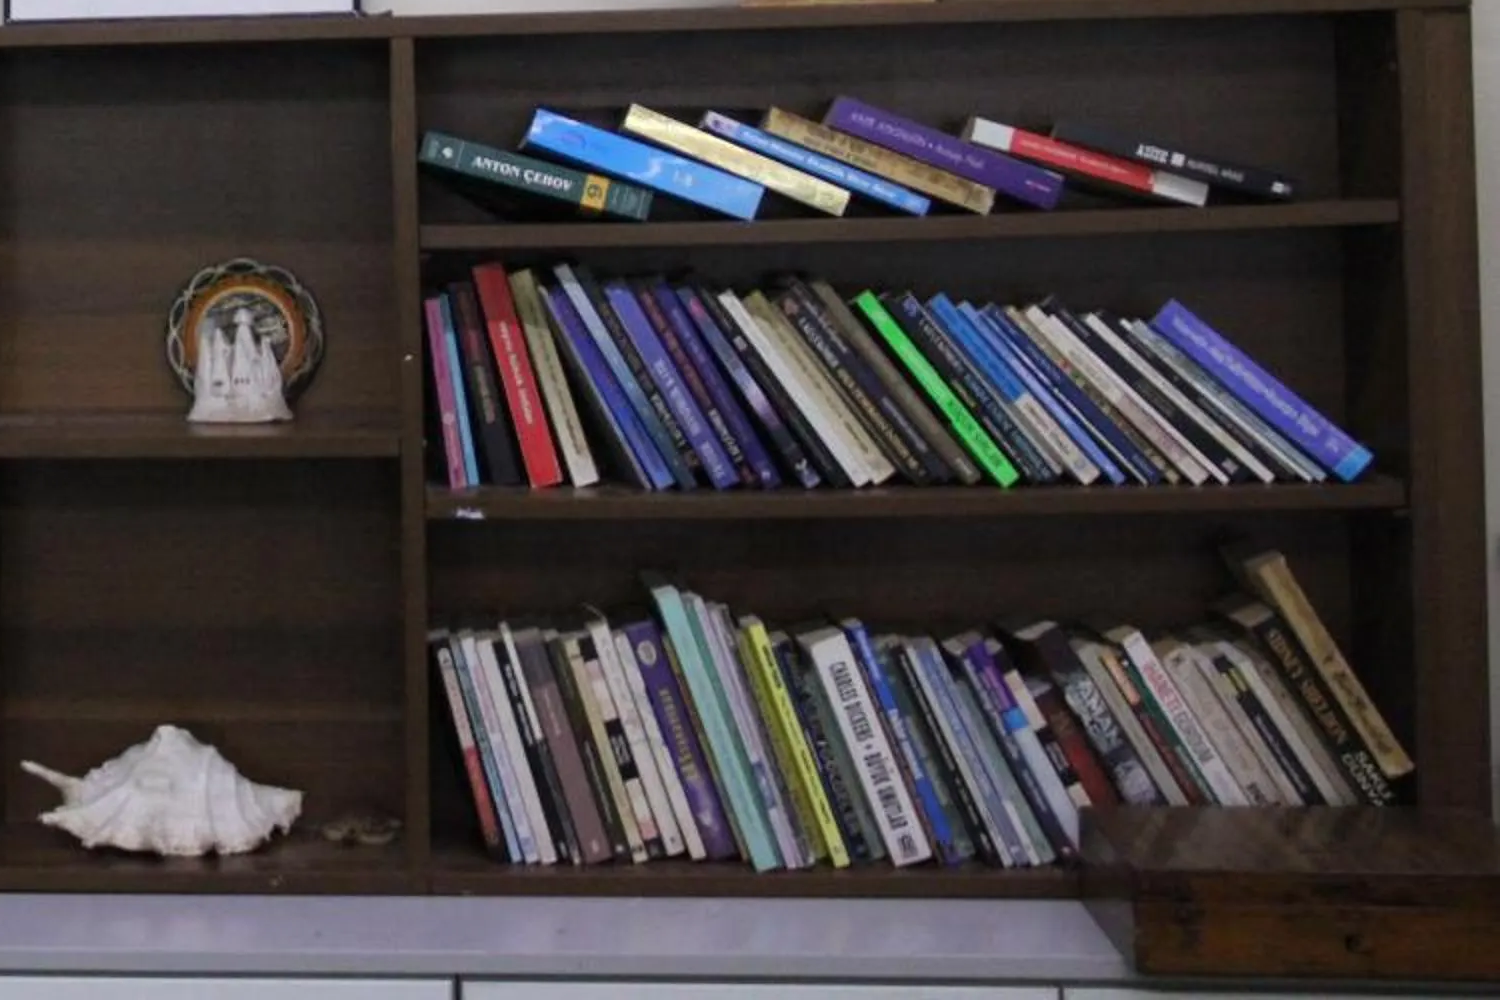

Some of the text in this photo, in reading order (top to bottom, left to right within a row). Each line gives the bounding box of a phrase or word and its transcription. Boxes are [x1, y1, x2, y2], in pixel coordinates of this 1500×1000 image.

[471, 154, 574, 194] ANTON ÇEHOV
[827, 659, 858, 702] CHARLES
[843, 700, 874, 743] DICKENS
[863, 749, 895, 786] BÜYÜK
[876, 784, 908, 831] UMUTLAR
